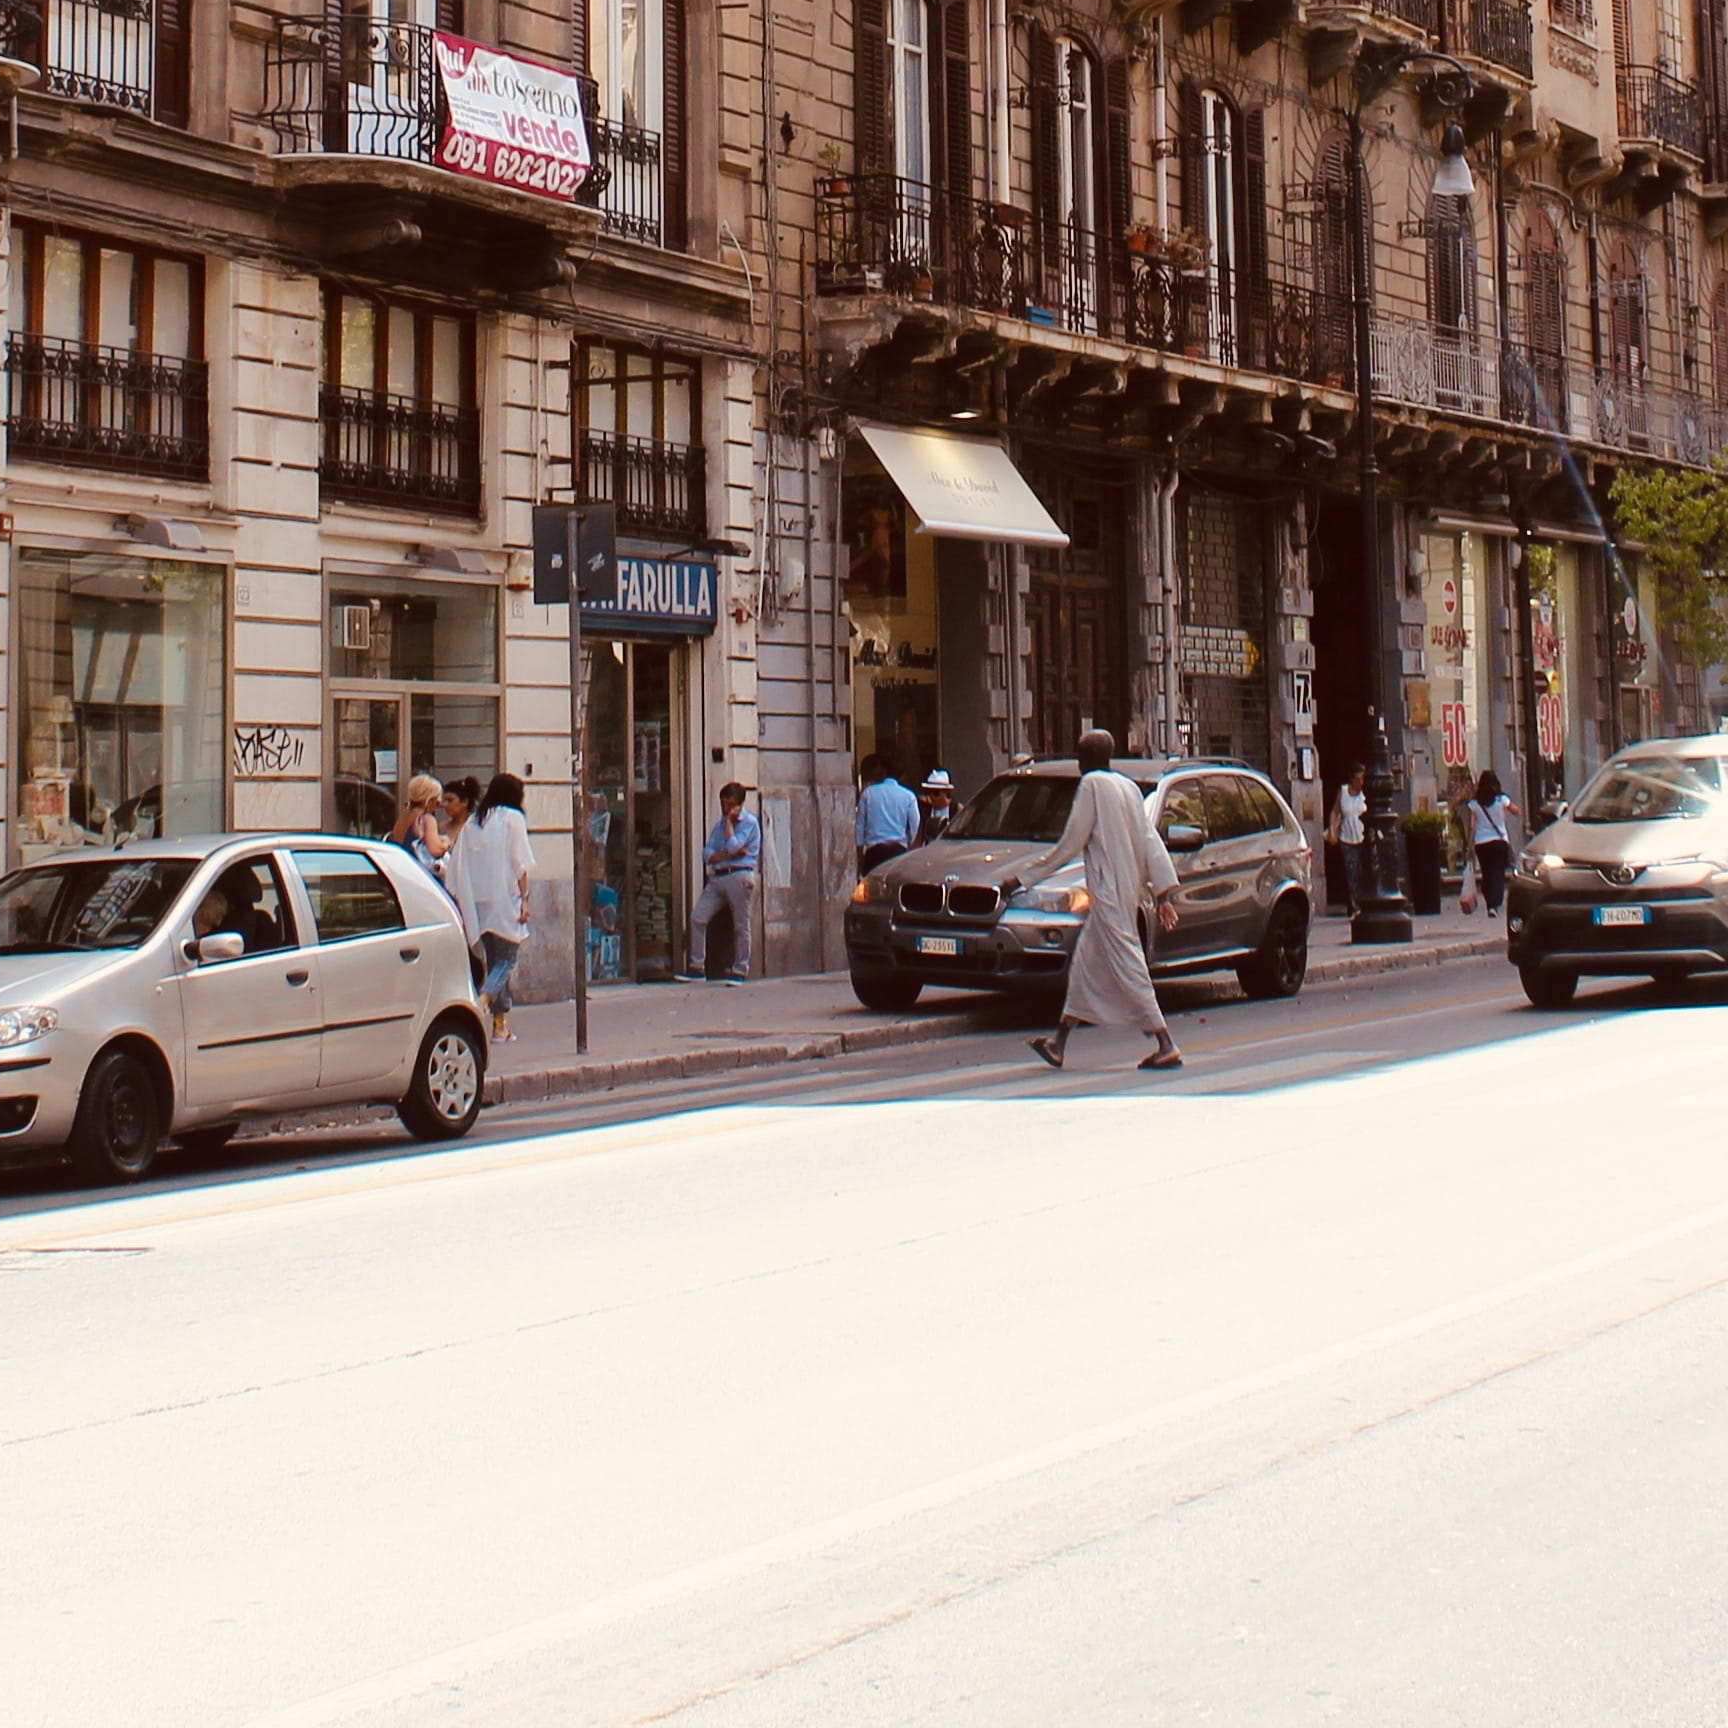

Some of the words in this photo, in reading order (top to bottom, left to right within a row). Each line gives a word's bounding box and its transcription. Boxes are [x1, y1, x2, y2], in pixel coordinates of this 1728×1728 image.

[437, 41, 465, 74] Qui
[492, 69, 579, 120] toscano
[443, 133, 488, 174] 091
[617, 560, 712, 616] FARULLA
